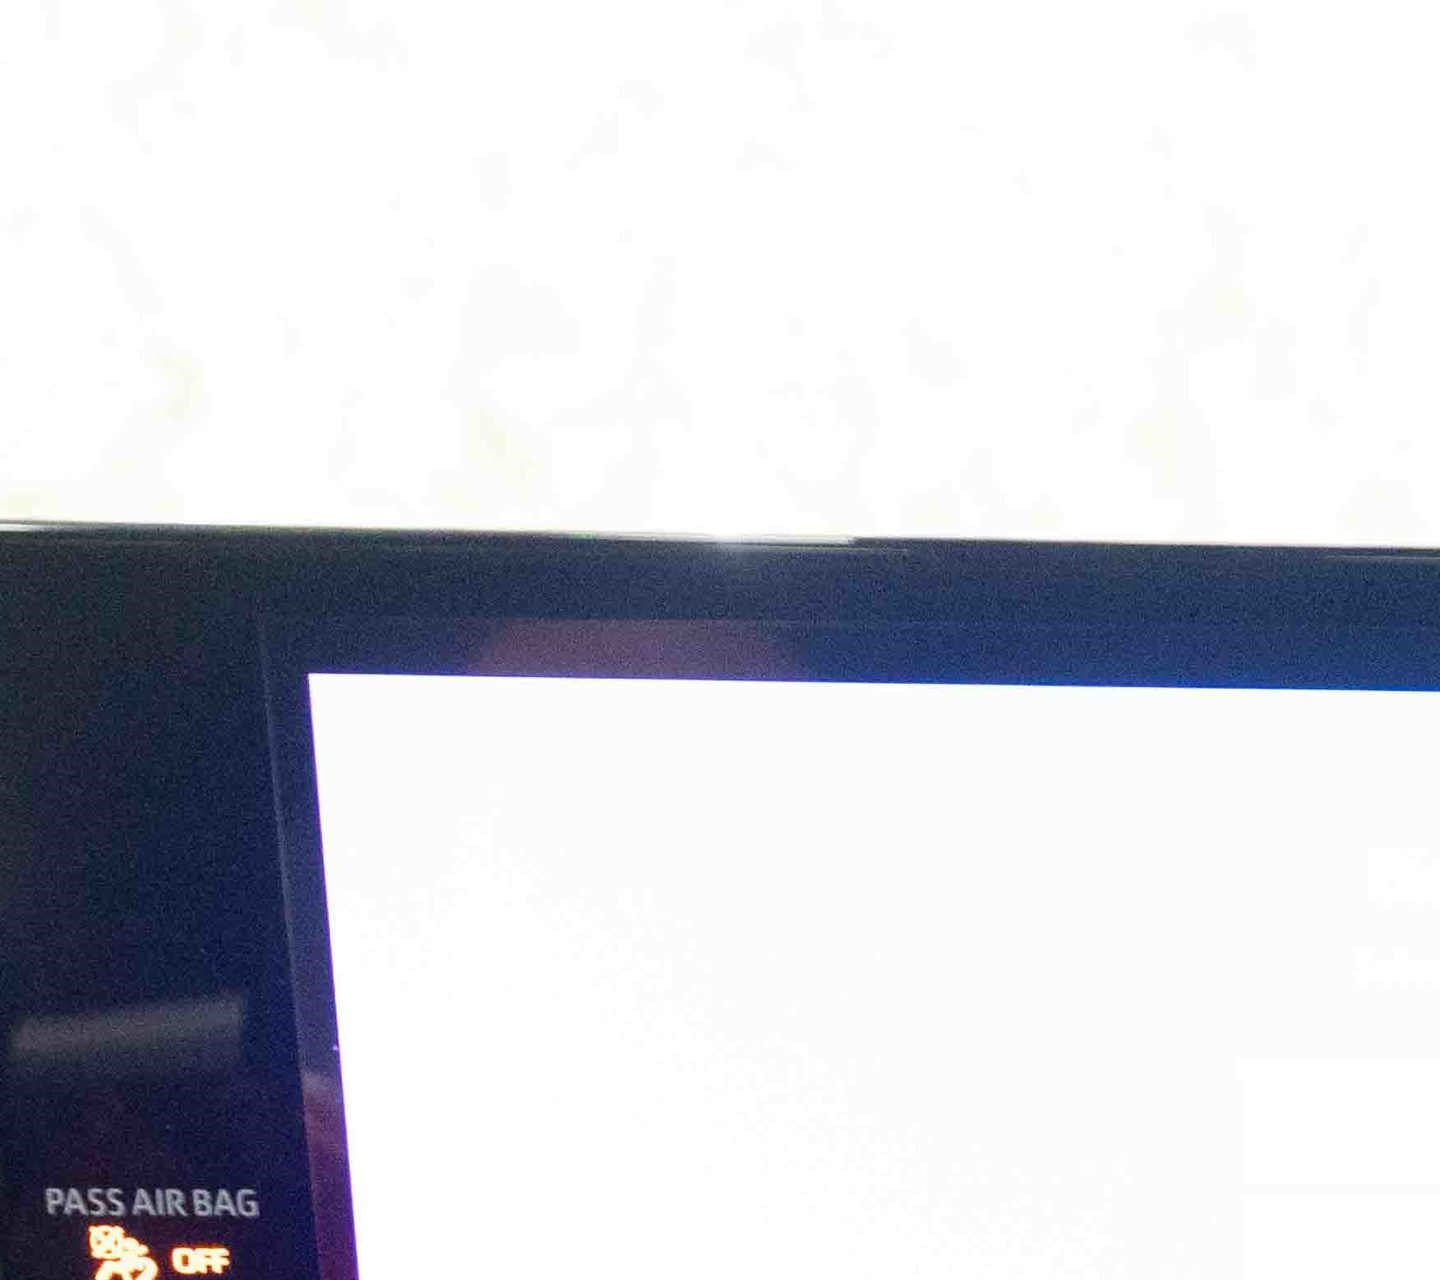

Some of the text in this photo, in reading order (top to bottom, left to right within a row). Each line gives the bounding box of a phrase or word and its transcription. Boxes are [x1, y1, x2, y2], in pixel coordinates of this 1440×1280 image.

[45, 1187, 259, 1217] PASS AIR BAG
[171, 1247, 230, 1275] OFF
